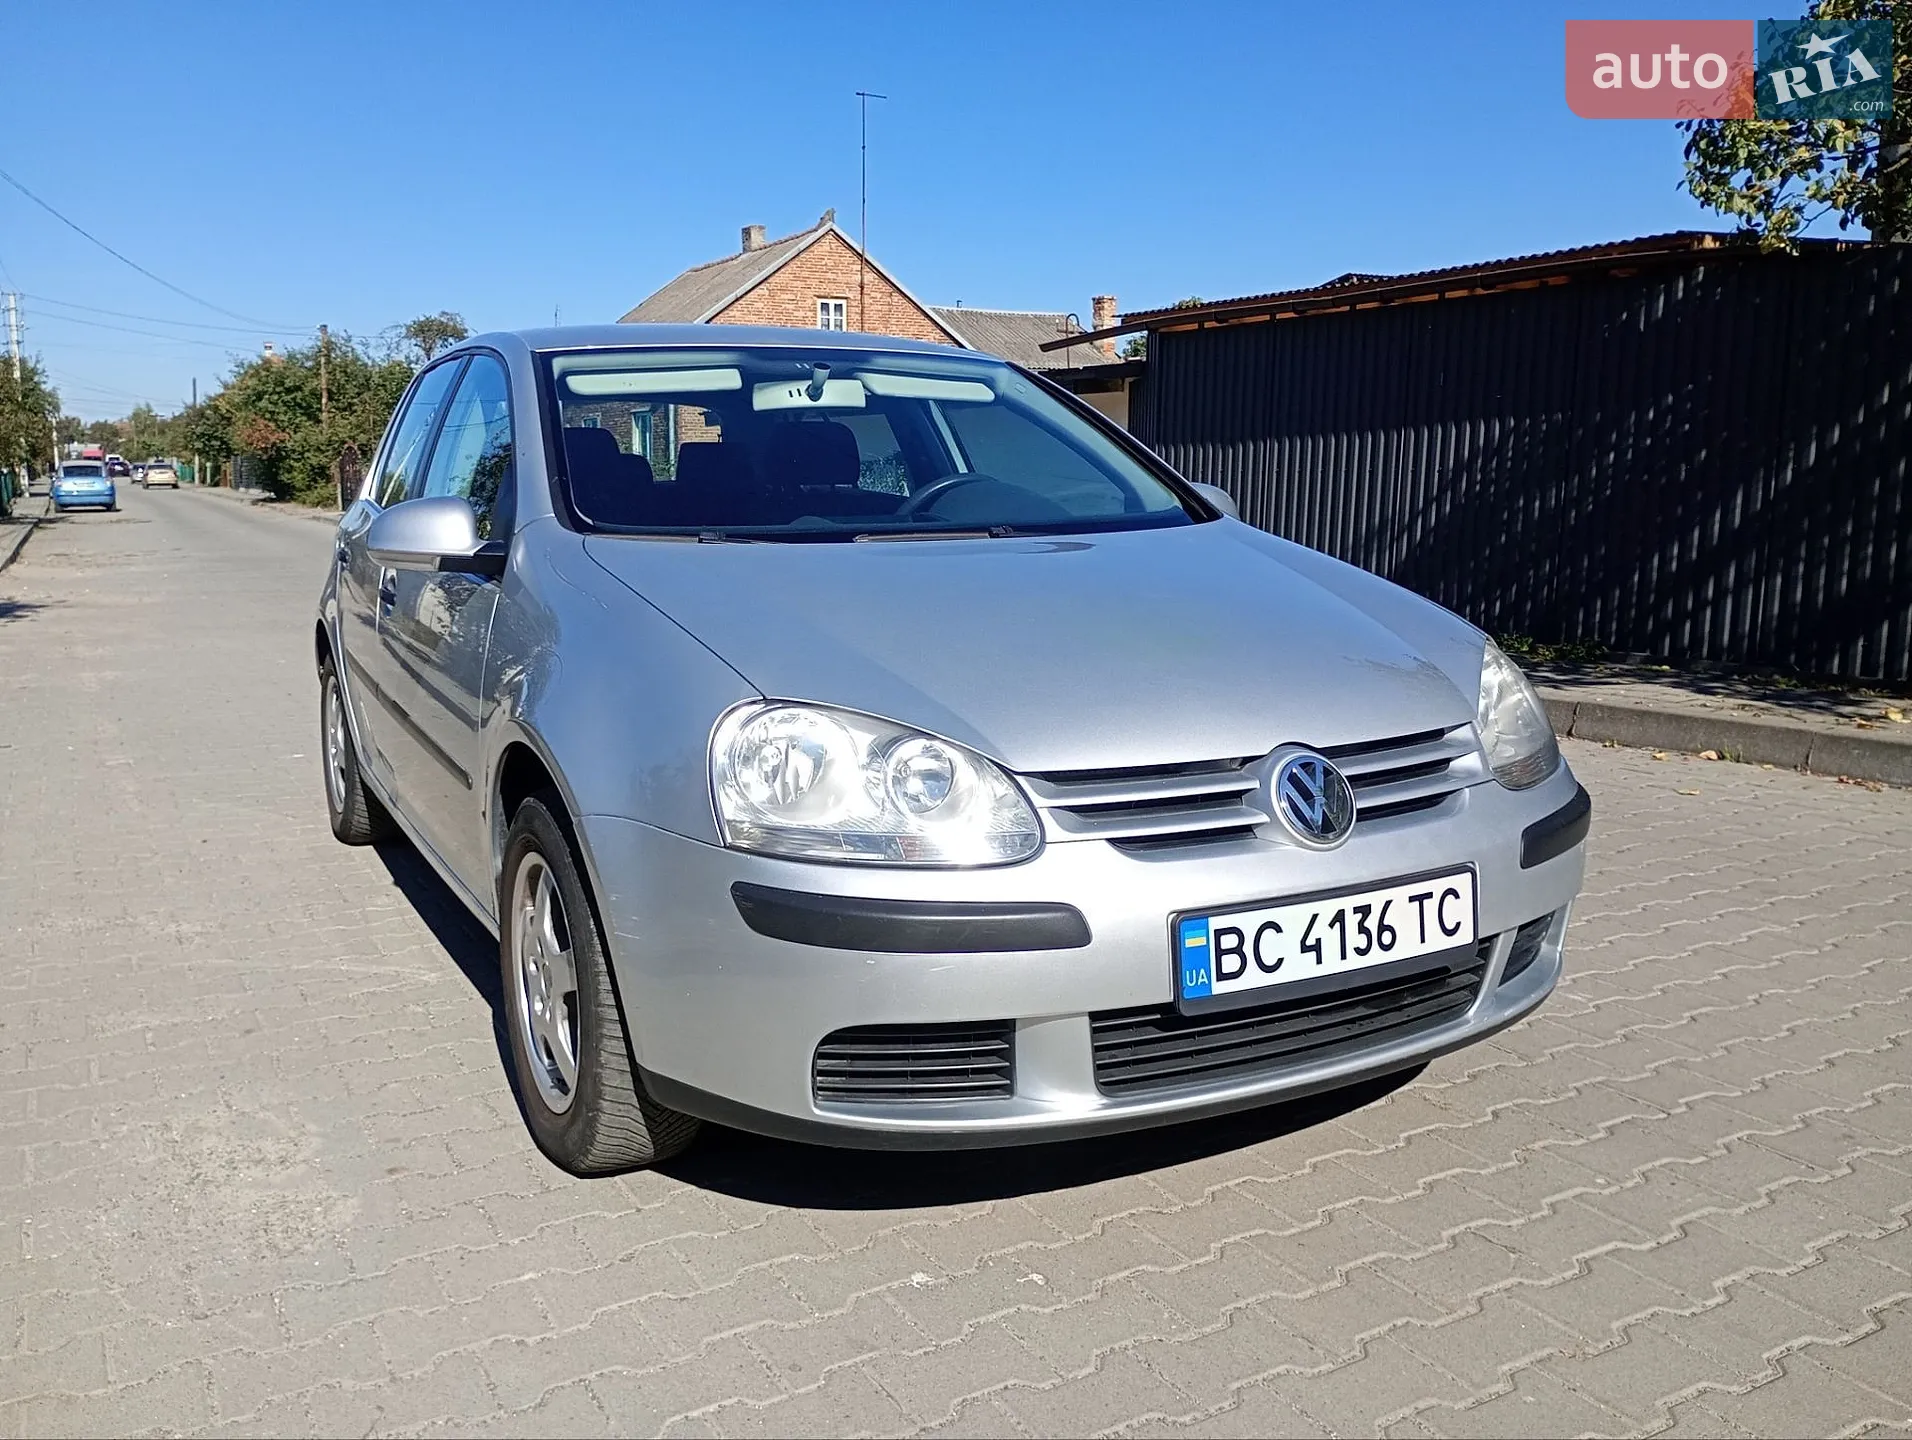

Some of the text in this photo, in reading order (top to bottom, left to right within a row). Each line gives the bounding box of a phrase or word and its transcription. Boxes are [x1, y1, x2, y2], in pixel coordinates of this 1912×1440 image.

[1213, 887, 1462, 982] BC 4136 TC
[1185, 967, 1209, 987] UA
